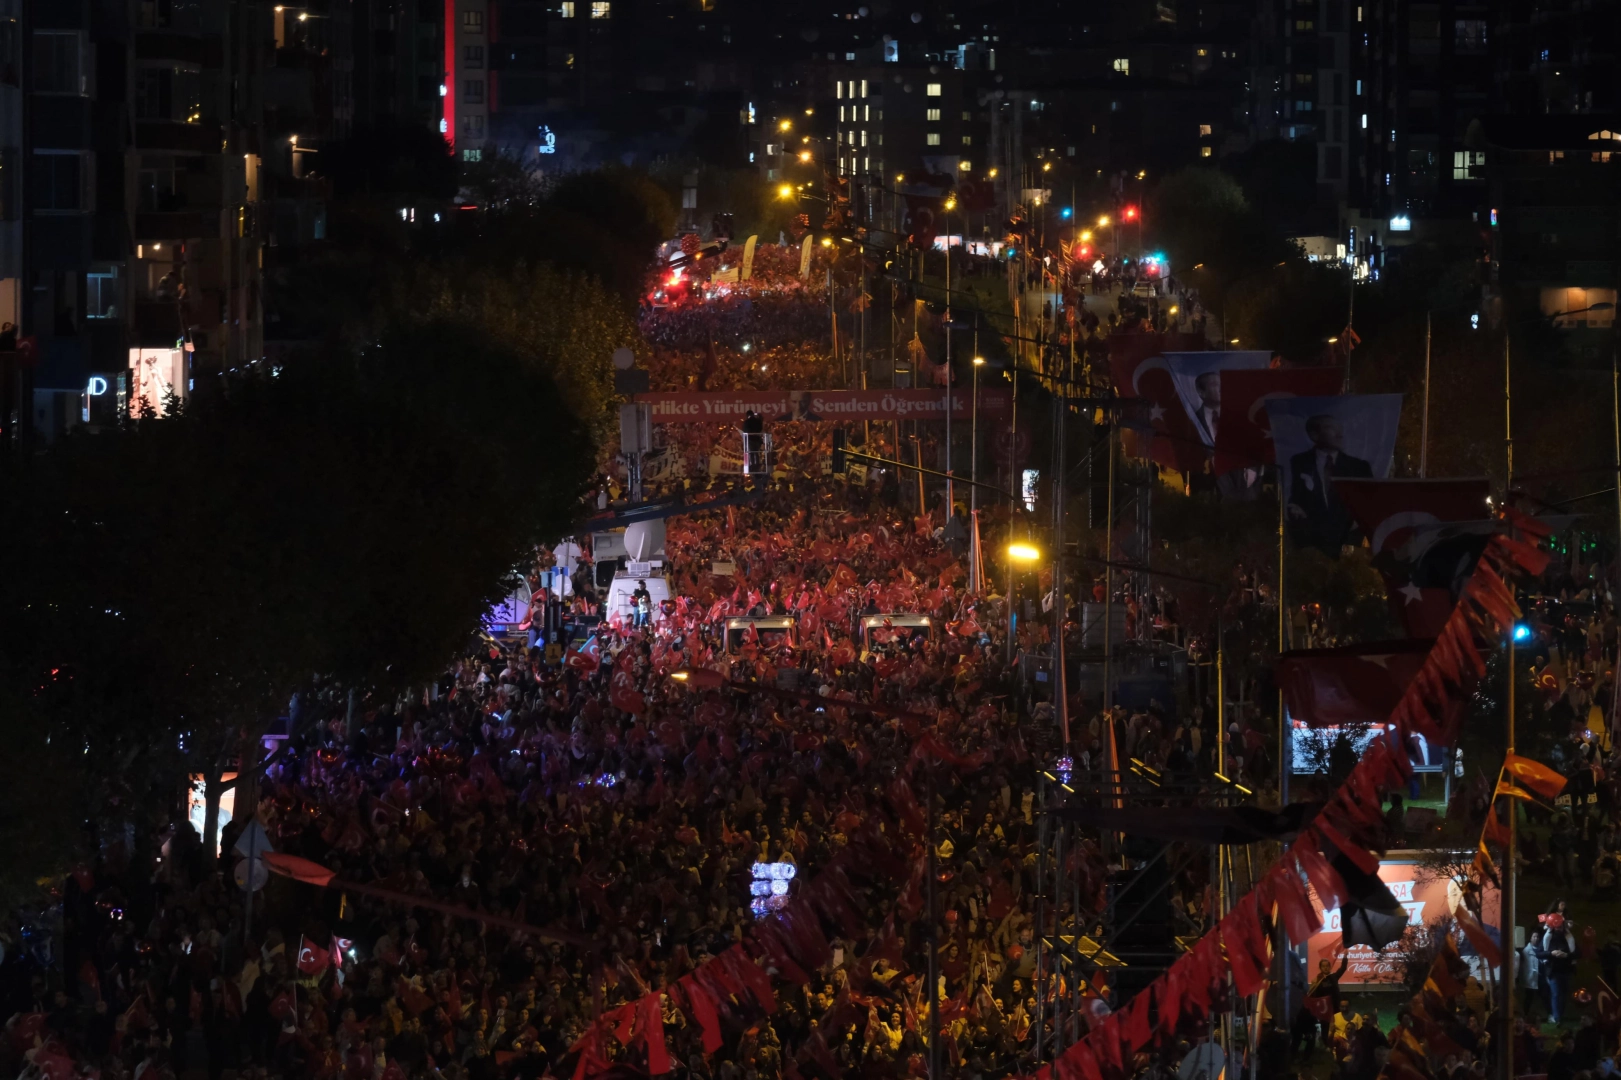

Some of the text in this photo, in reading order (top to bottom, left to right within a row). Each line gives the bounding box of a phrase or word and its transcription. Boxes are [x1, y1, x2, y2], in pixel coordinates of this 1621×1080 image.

[702, 399, 787, 418] Yürümeyi
[812, 397, 878, 413] Senden
[881, 393, 964, 415] Öğrendk
